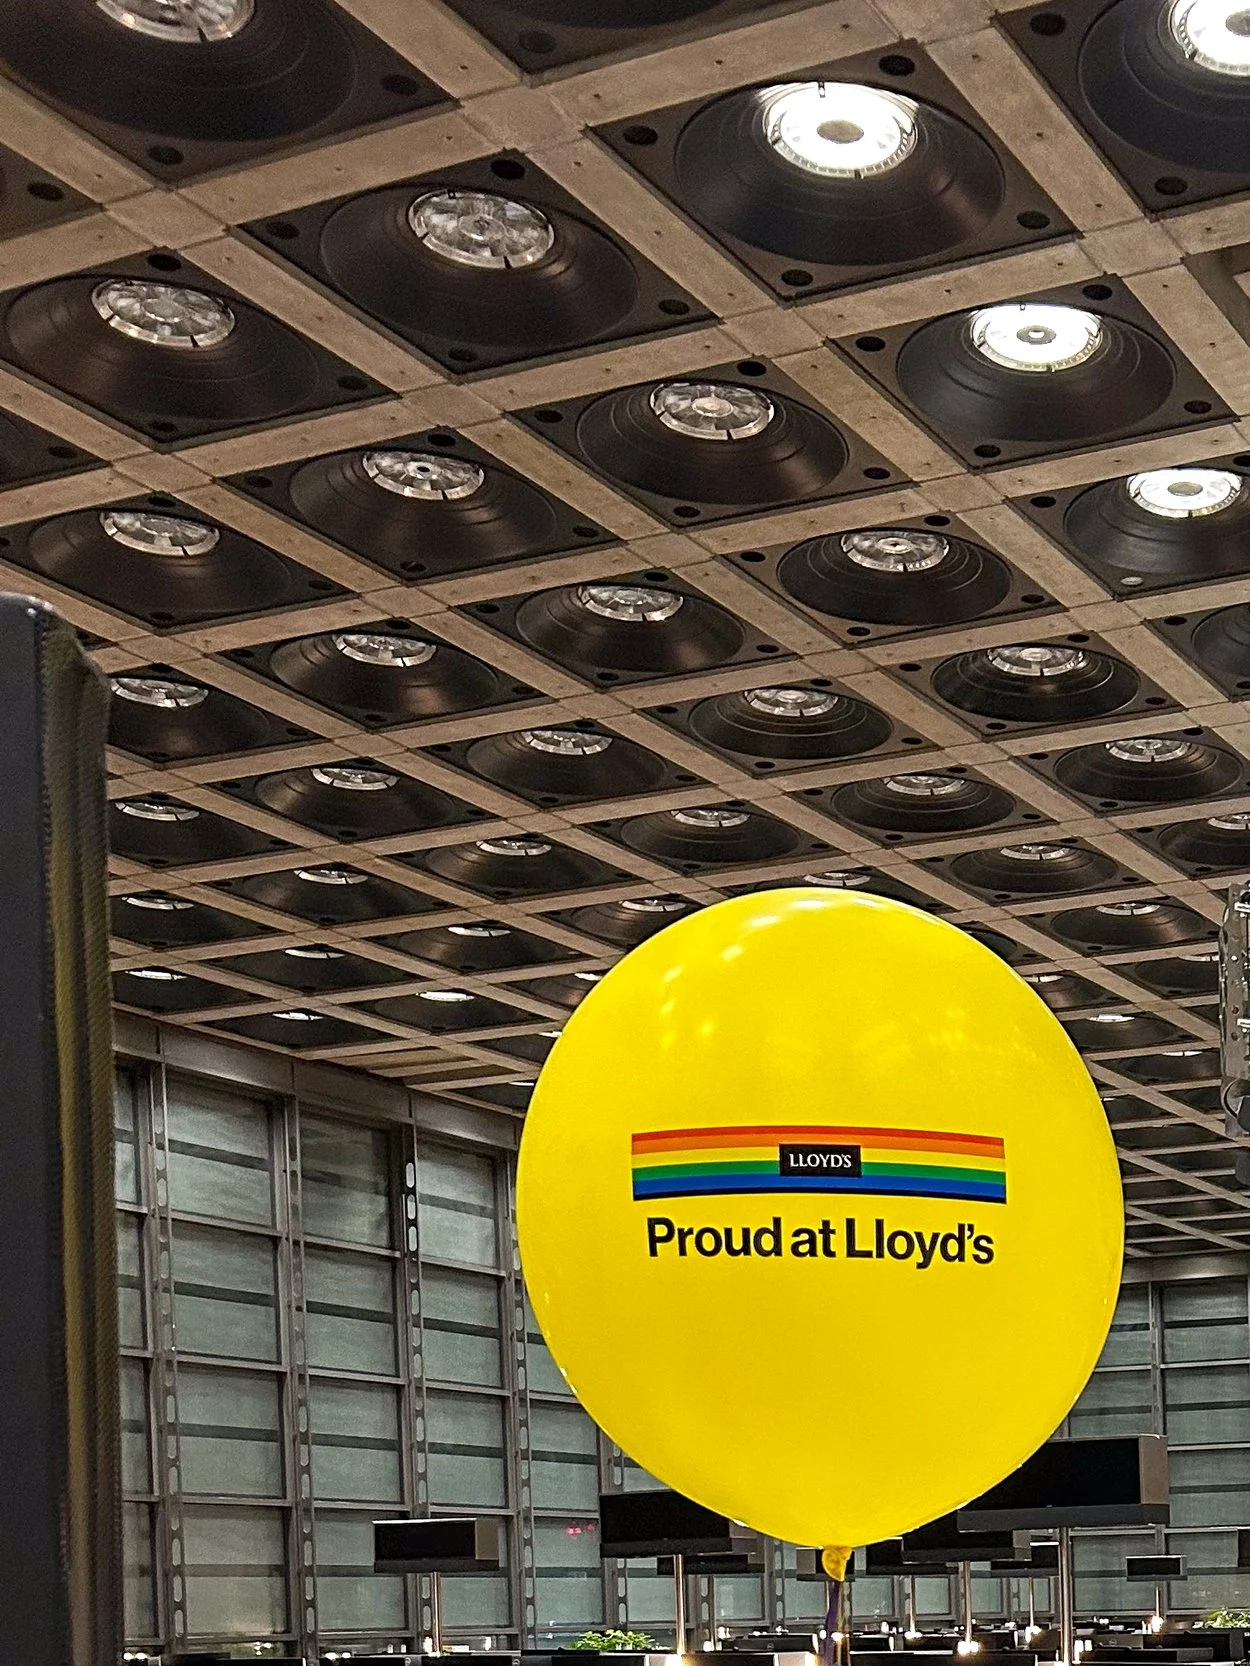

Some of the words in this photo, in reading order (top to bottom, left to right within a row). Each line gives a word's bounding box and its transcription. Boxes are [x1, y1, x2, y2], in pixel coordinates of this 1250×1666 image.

[789, 1153, 852, 1168] LLOYD'S
[647, 1216, 782, 1258] Proud
[791, 1219, 837, 1259] at
[846, 1217, 995, 1270] Lloyd's
